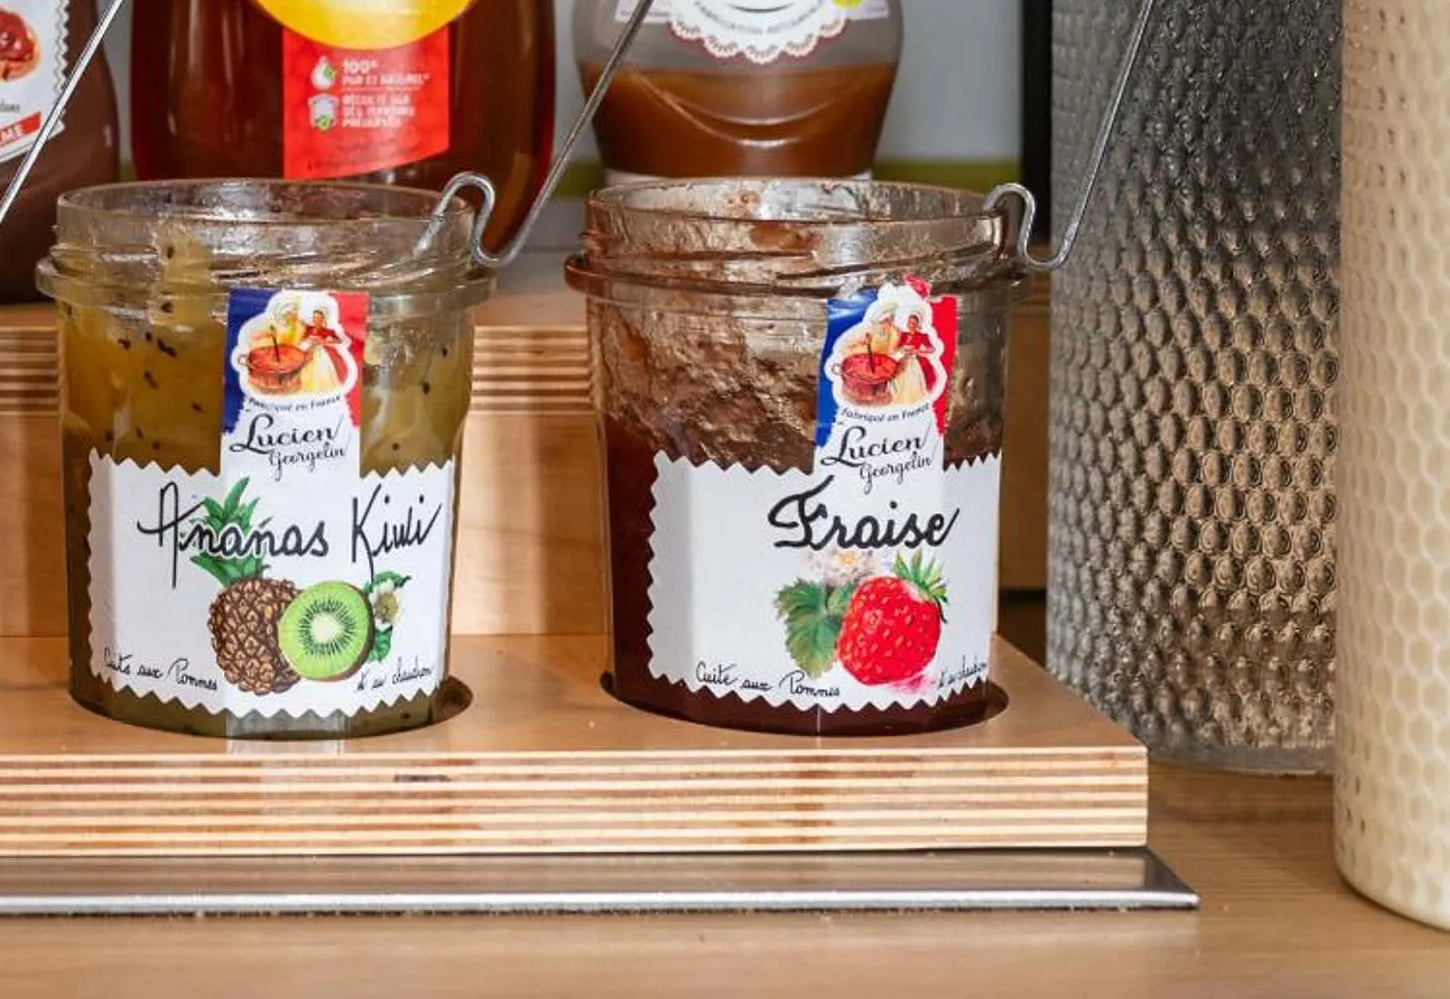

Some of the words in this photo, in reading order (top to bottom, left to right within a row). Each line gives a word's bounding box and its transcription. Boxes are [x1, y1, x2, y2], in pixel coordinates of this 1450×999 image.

[229, 414, 343, 453] Lucien
[821, 425, 930, 468] Lucien
[268, 442, 348, 482] Georgelin
[859, 450, 933, 495] Georgelin
[767, 474, 961, 551] Fraise
[137, 481, 330, 589] Ananas
[350, 483, 443, 583] Kiwi
[167, 657, 218, 691] Pommes
[740, 679, 773, 692] aux
[778, 670, 840, 697] Pommes
